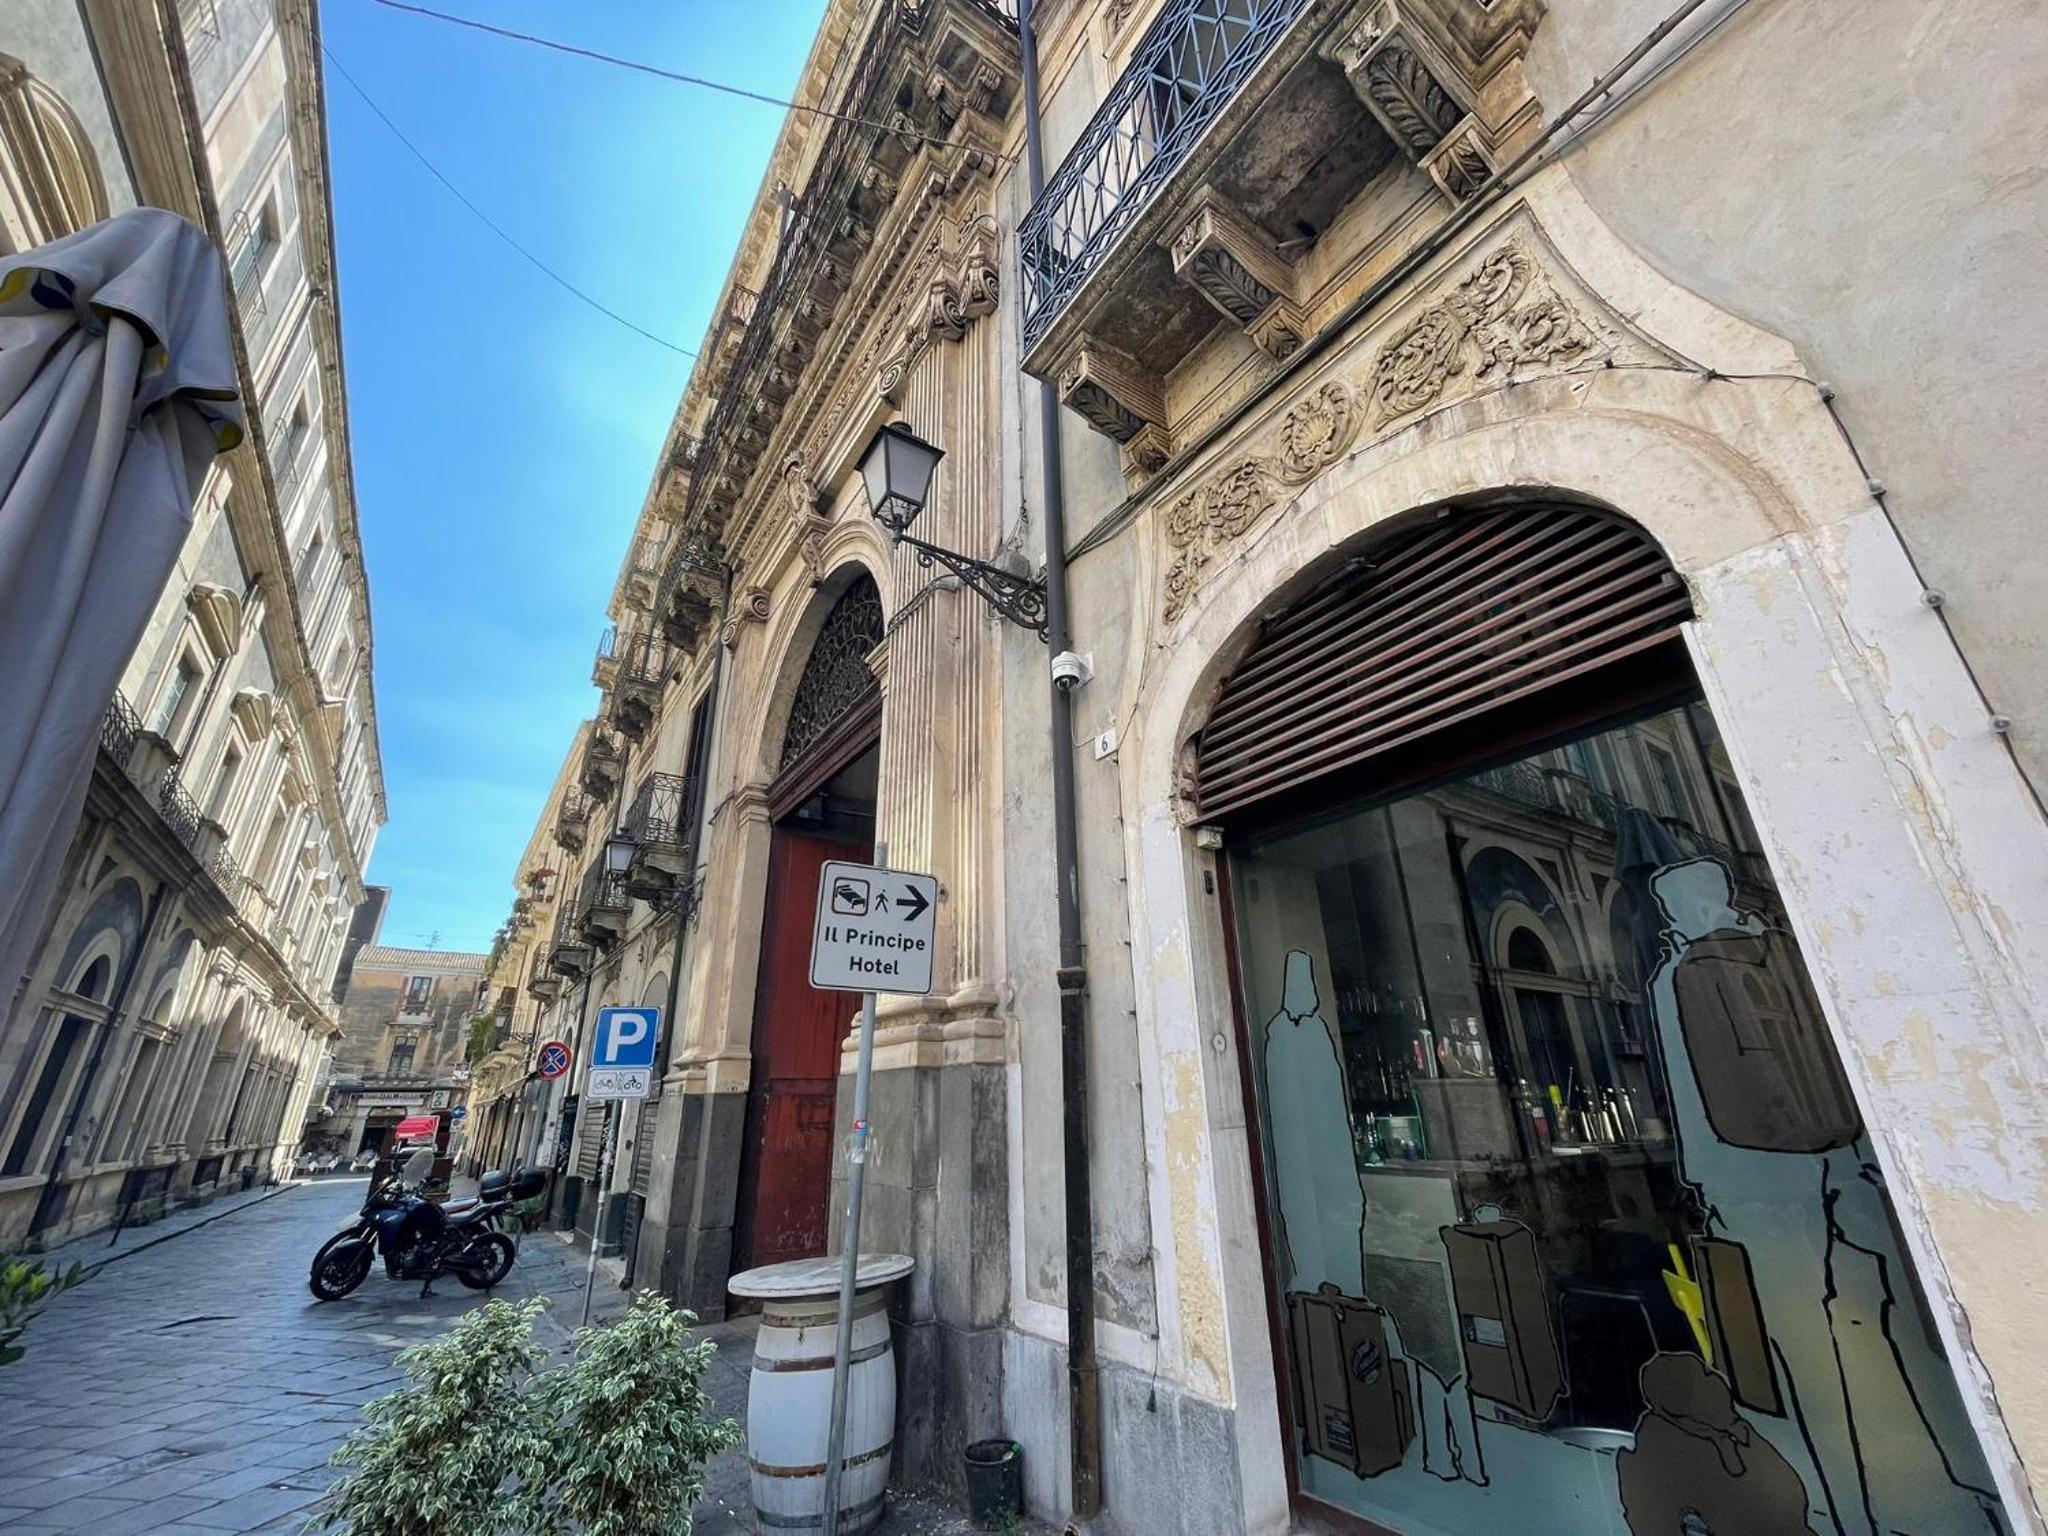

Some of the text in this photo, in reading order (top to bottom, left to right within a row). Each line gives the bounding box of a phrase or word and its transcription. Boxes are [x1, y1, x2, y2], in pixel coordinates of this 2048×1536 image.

[1101, 736, 1109, 752] 6
[824, 926, 926, 952] Il Principe
[849, 956, 900, 975] Hotel
[605, 1012, 648, 1062] P
